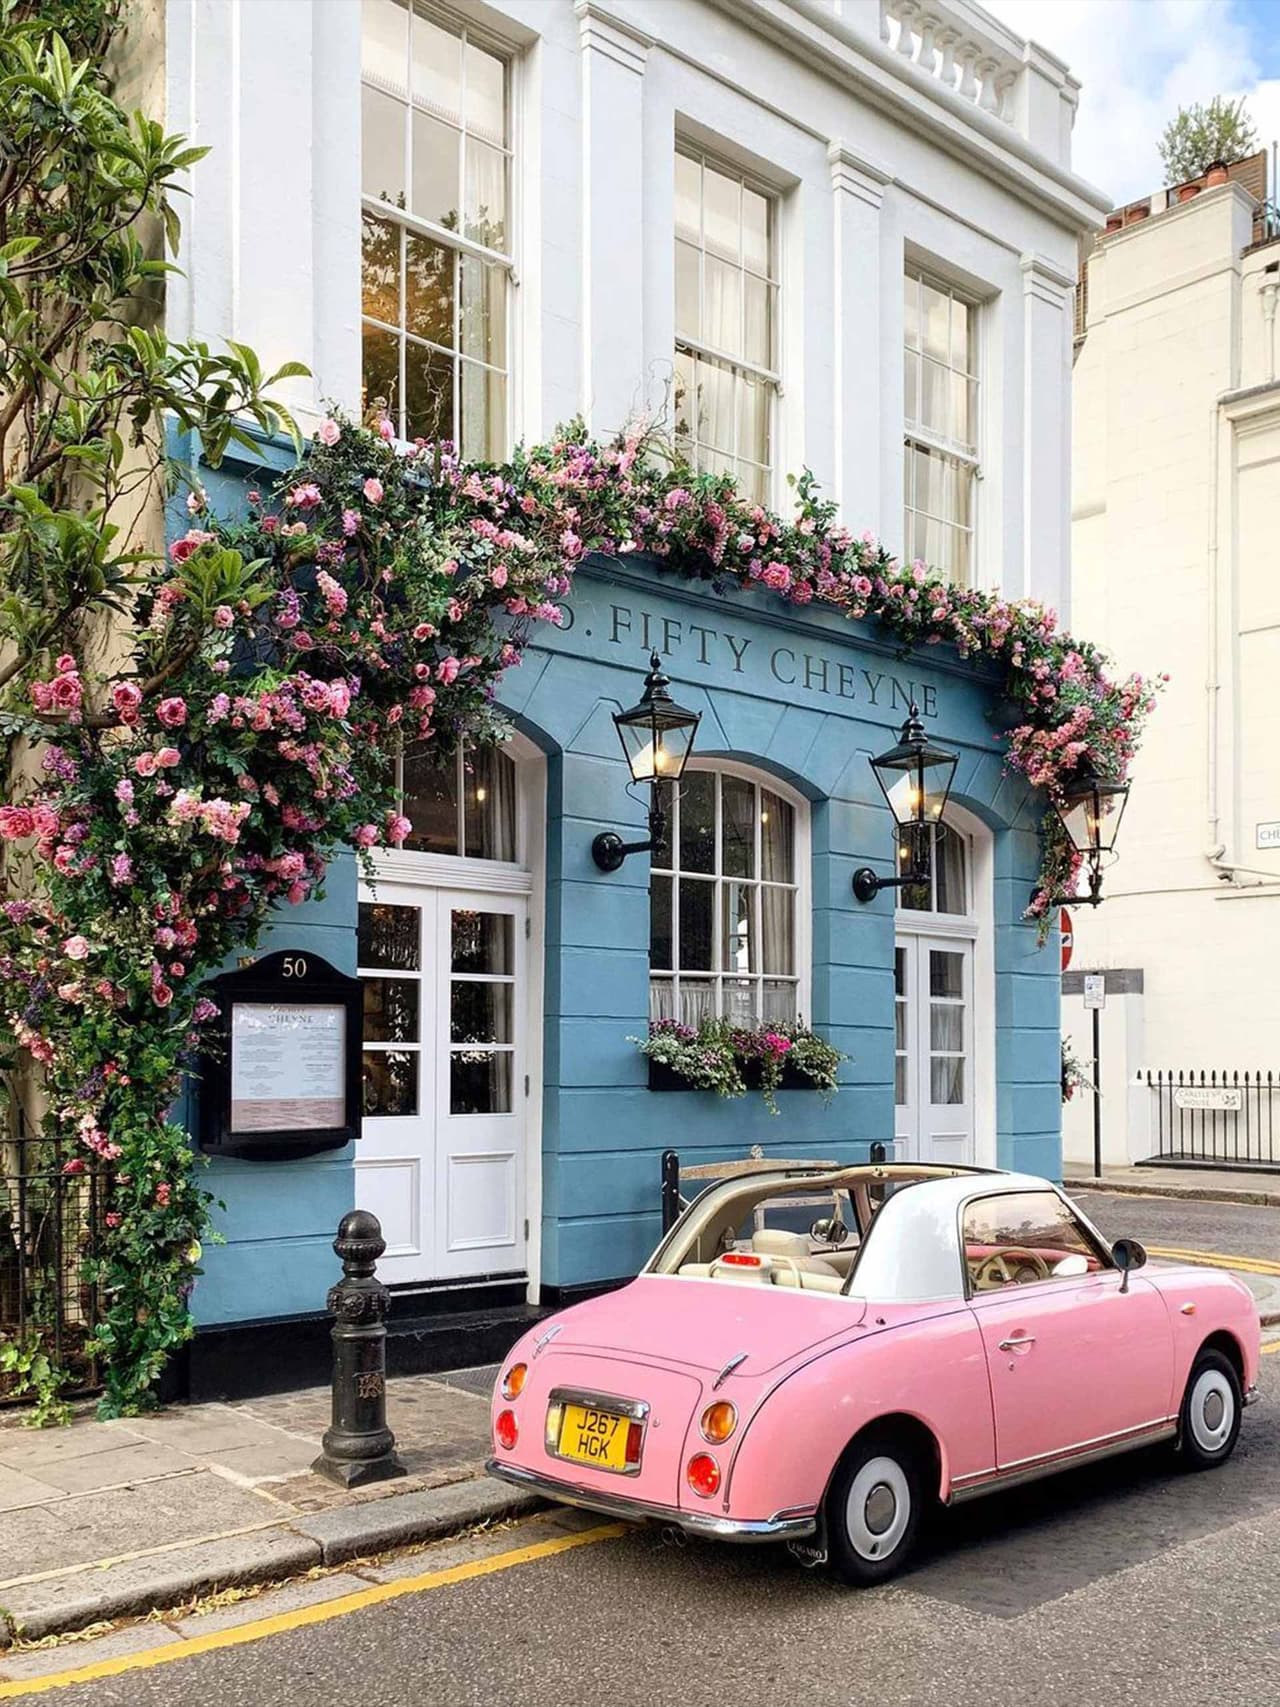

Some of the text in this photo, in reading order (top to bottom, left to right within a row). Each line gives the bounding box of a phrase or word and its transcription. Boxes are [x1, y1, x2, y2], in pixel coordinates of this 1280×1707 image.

[608, 604, 753, 673] FIFTY
[770, 647, 940, 719] CHEYNE
[282, 957, 308, 978] 50
[577, 1410, 621, 1438] J267
[577, 1433, 611, 1460] HGK
